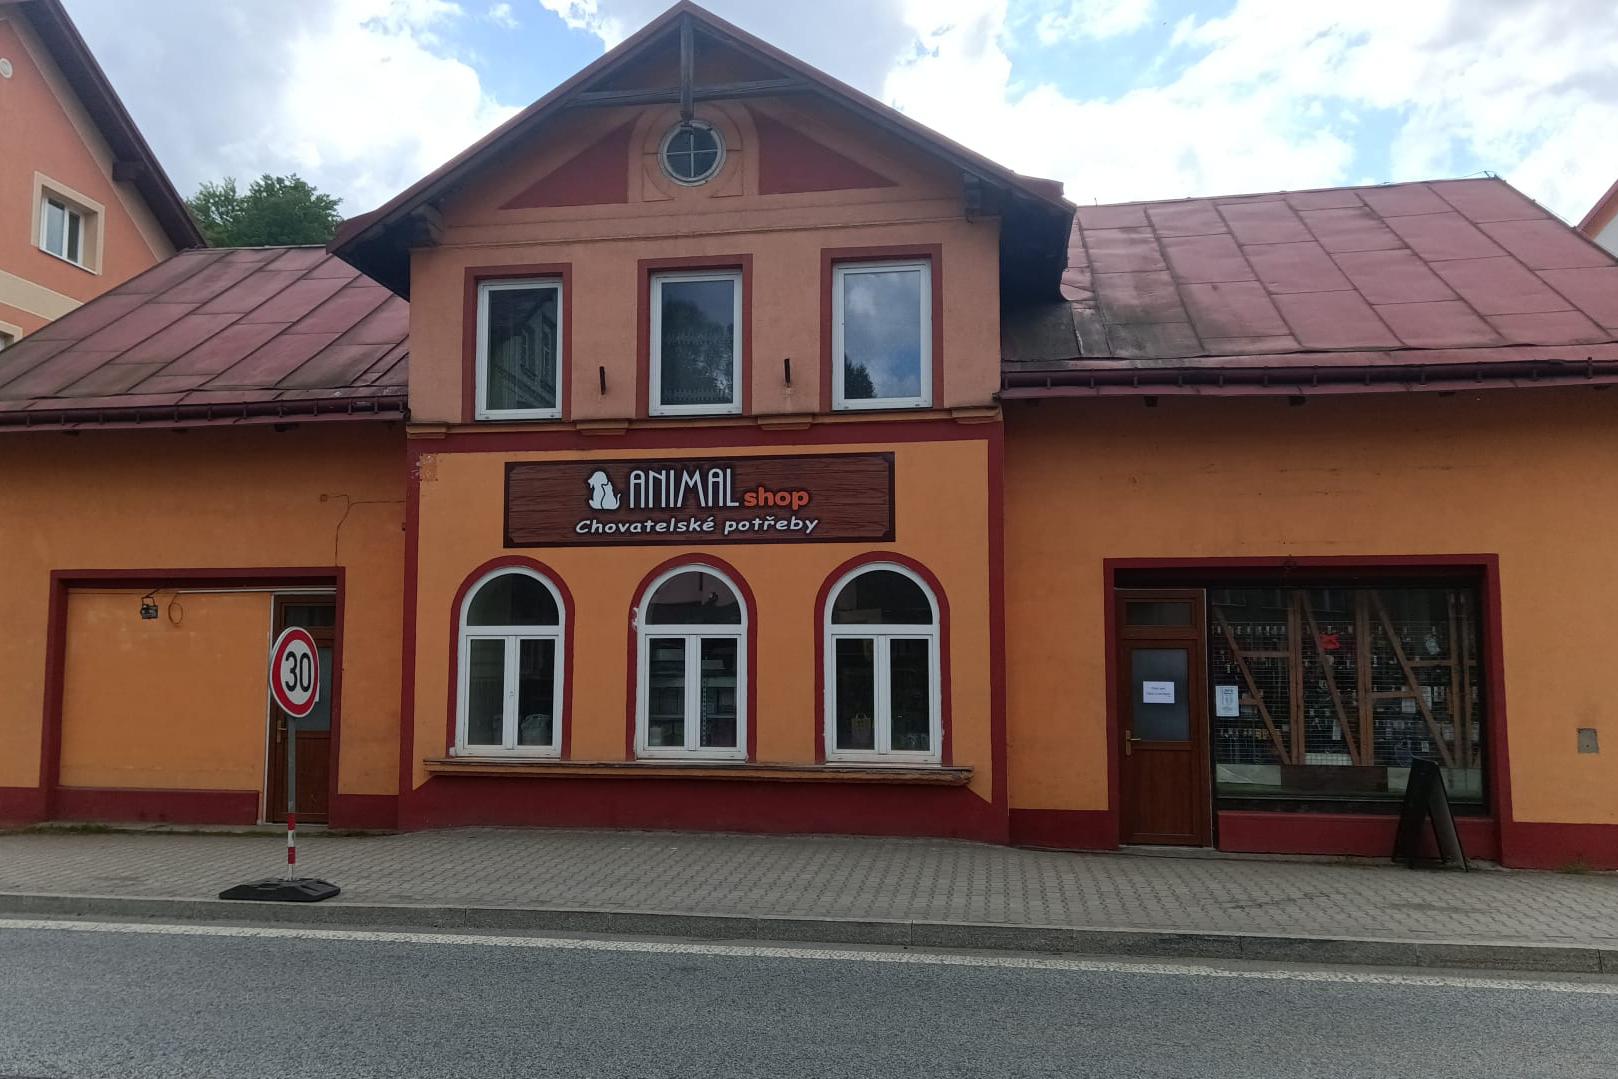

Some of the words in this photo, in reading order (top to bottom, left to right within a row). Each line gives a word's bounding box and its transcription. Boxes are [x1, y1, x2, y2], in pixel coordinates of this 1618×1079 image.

[629, 468, 739, 509] ANIMAL
[743, 487, 809, 510] shop
[575, 517, 715, 534] Chovatelské
[724, 515, 819, 535] potřeby
[285, 651, 312, 692] 30
